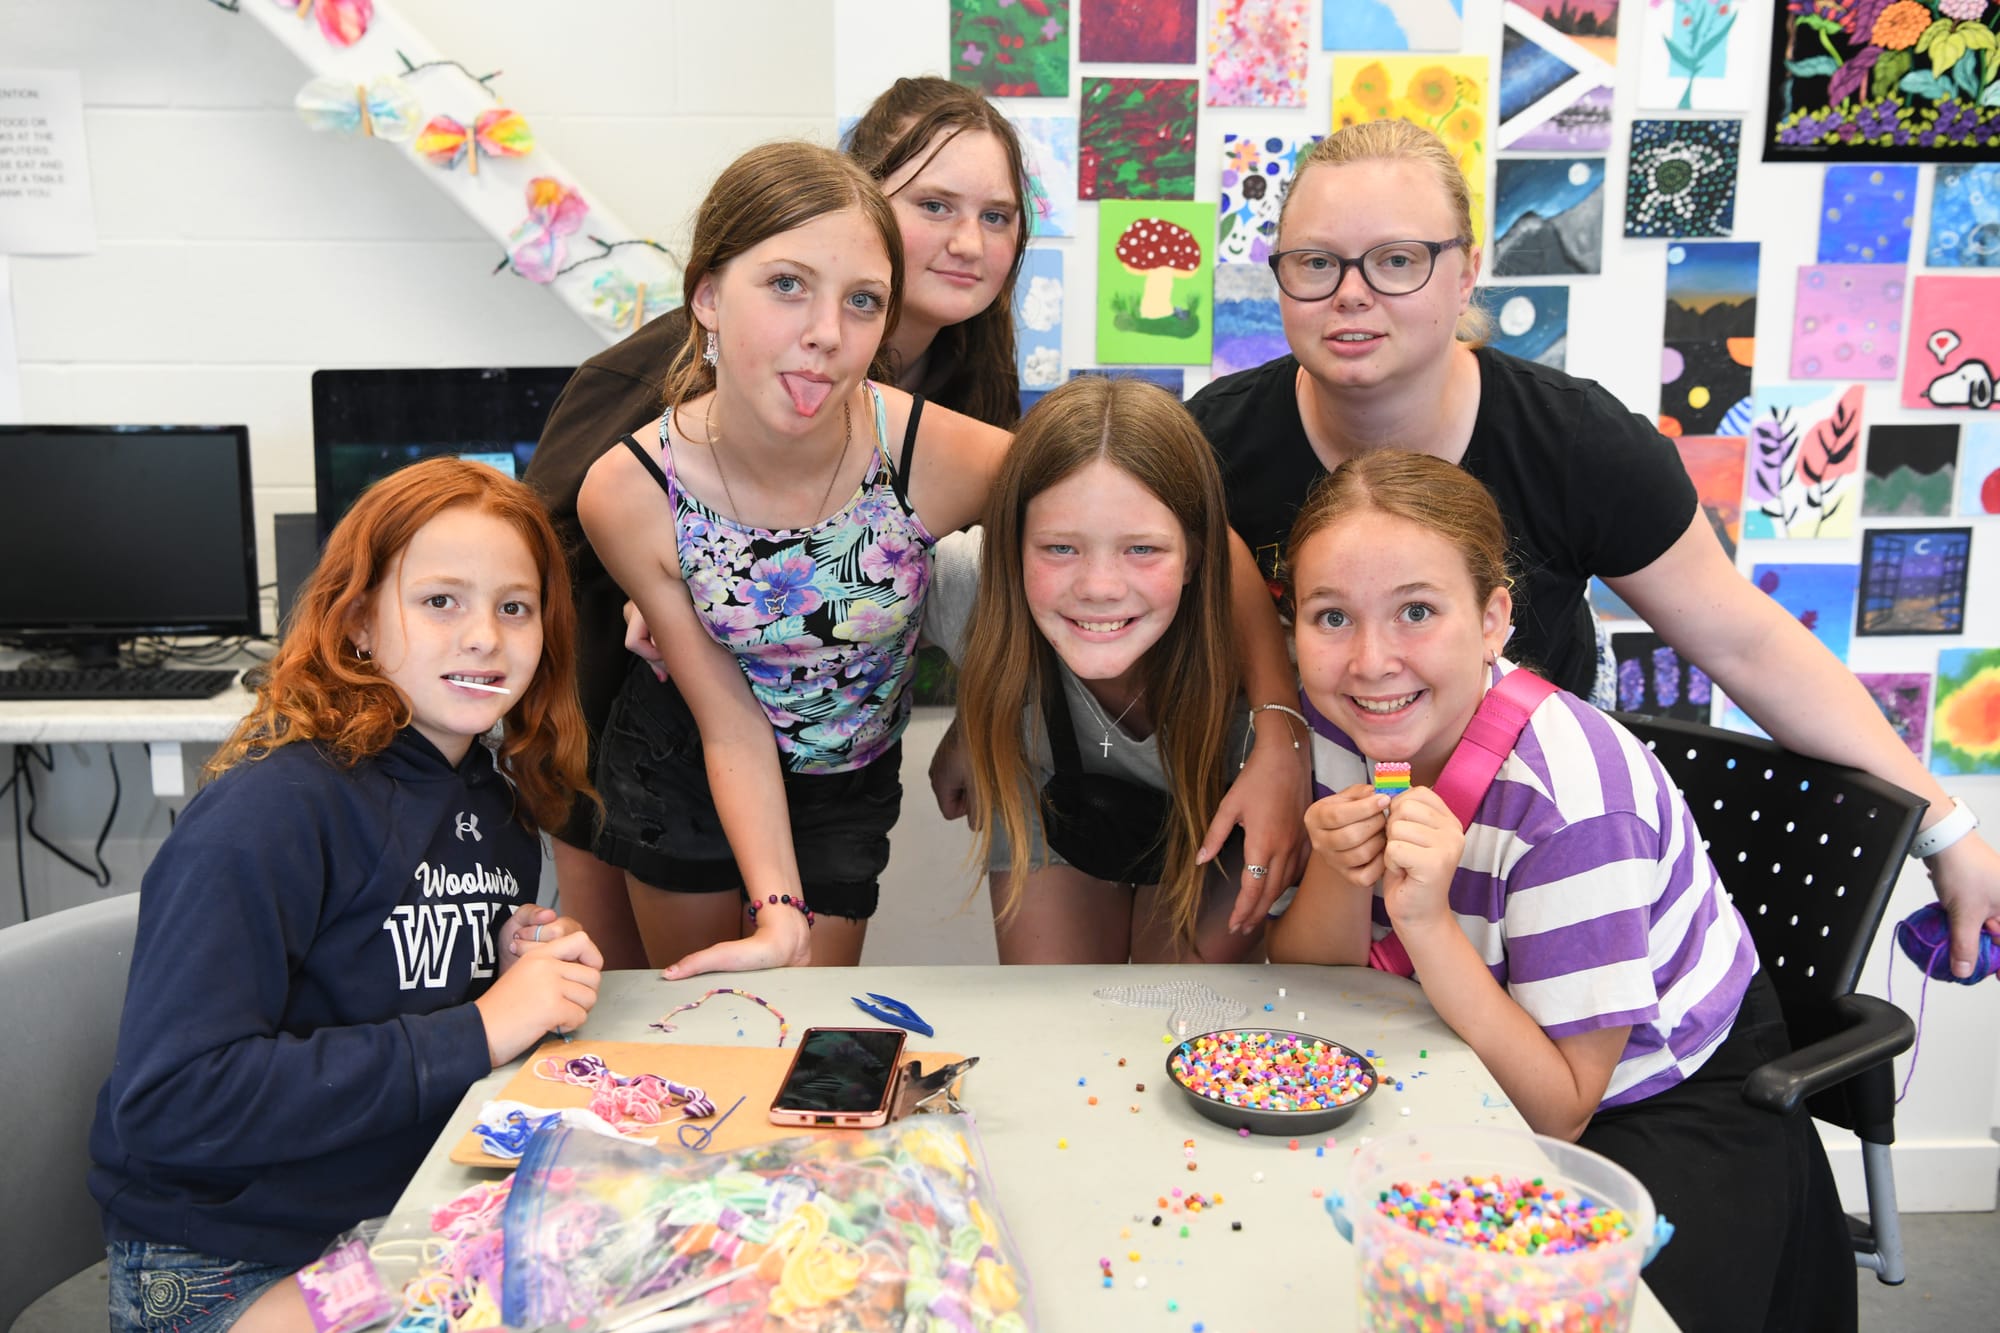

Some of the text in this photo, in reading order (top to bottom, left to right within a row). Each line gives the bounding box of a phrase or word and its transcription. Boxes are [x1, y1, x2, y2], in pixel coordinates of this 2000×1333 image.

[31, 118, 47, 127] OR
[17, 132, 29, 141] AT
[34, 132, 54, 141] THE
[16, 160, 36, 169] EAT
[40, 160, 63, 169] AND
[414, 861, 520, 898] Woolwich
